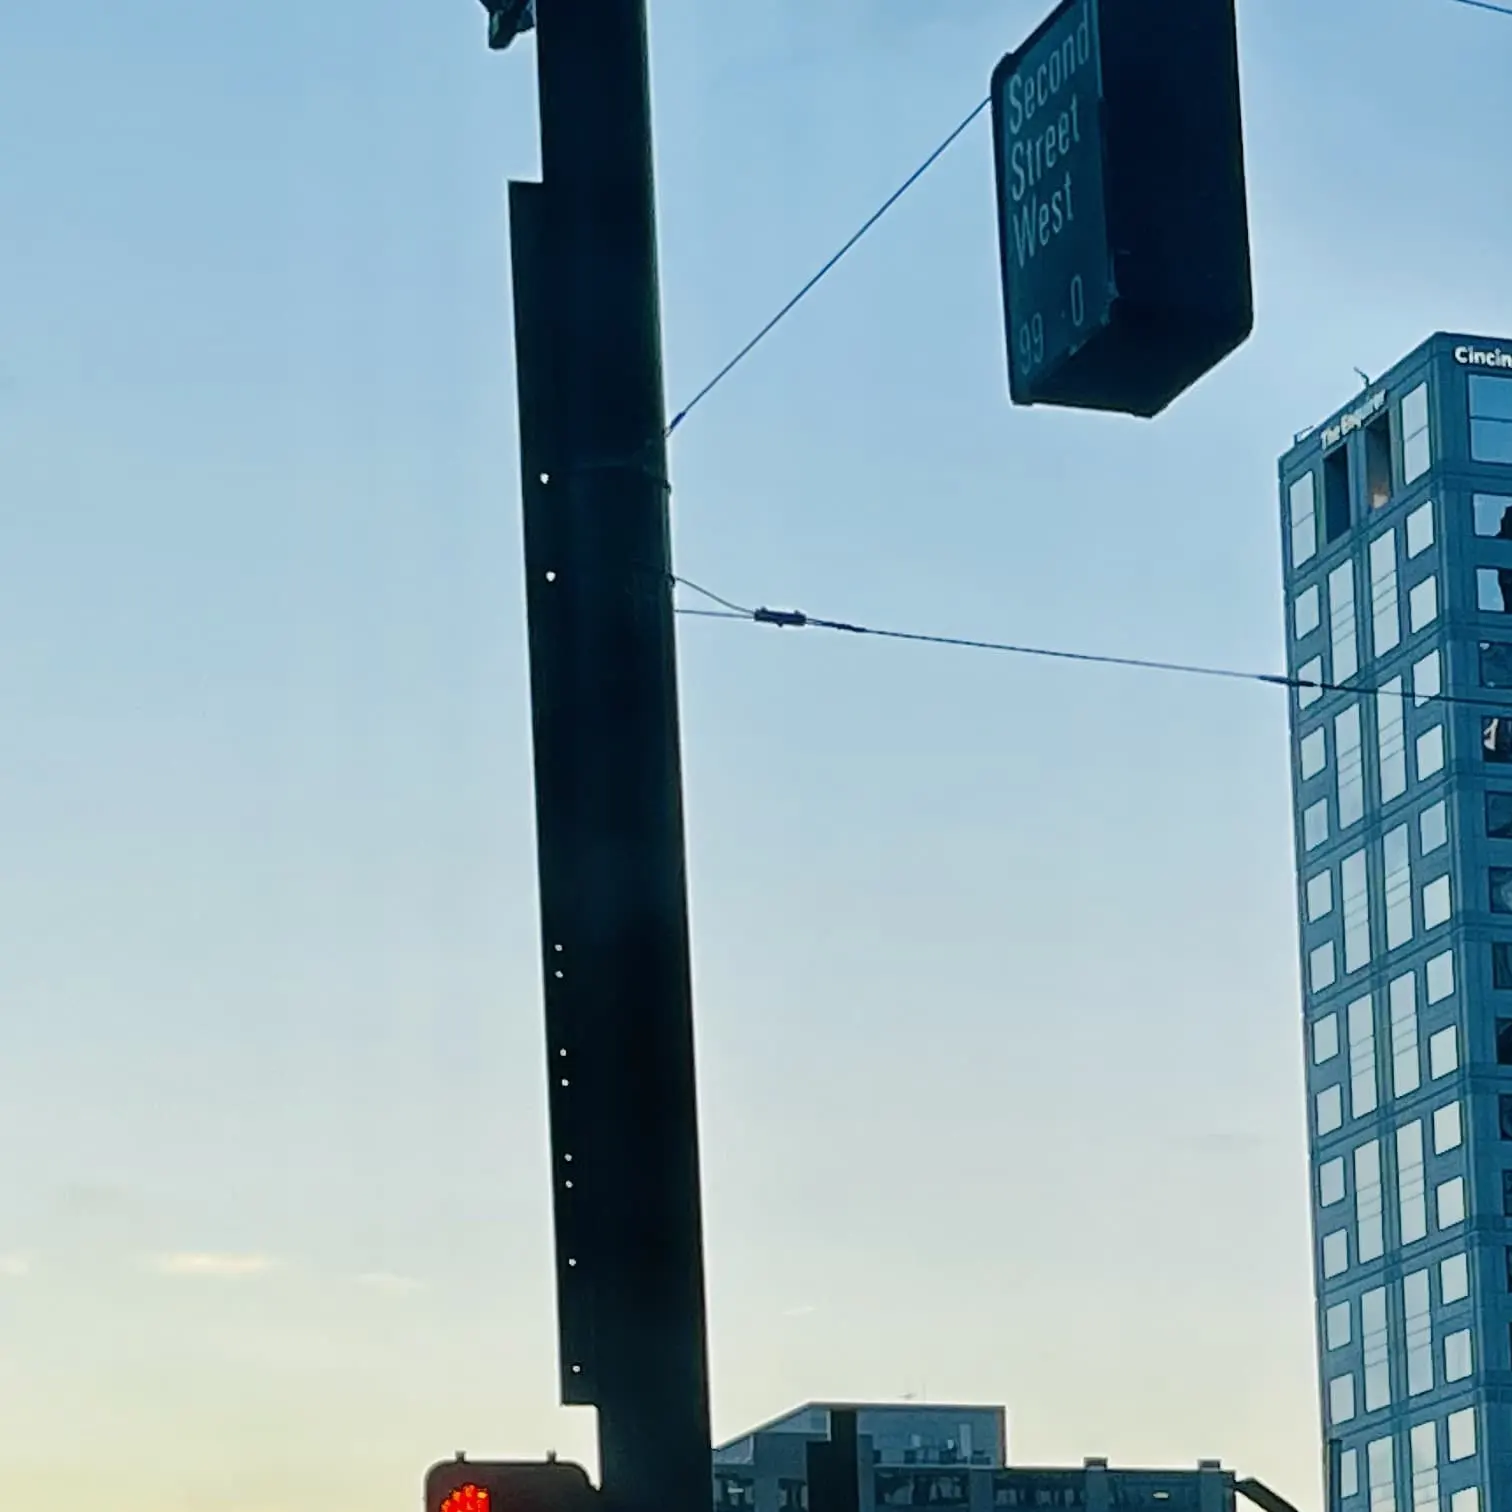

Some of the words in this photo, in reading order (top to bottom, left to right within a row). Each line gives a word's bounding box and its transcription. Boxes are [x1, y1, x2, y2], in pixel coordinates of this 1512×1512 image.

[1008, 0, 1090, 135] Second
[1010, 92, 1080, 201] Street
[1012, 171, 1075, 269] West
